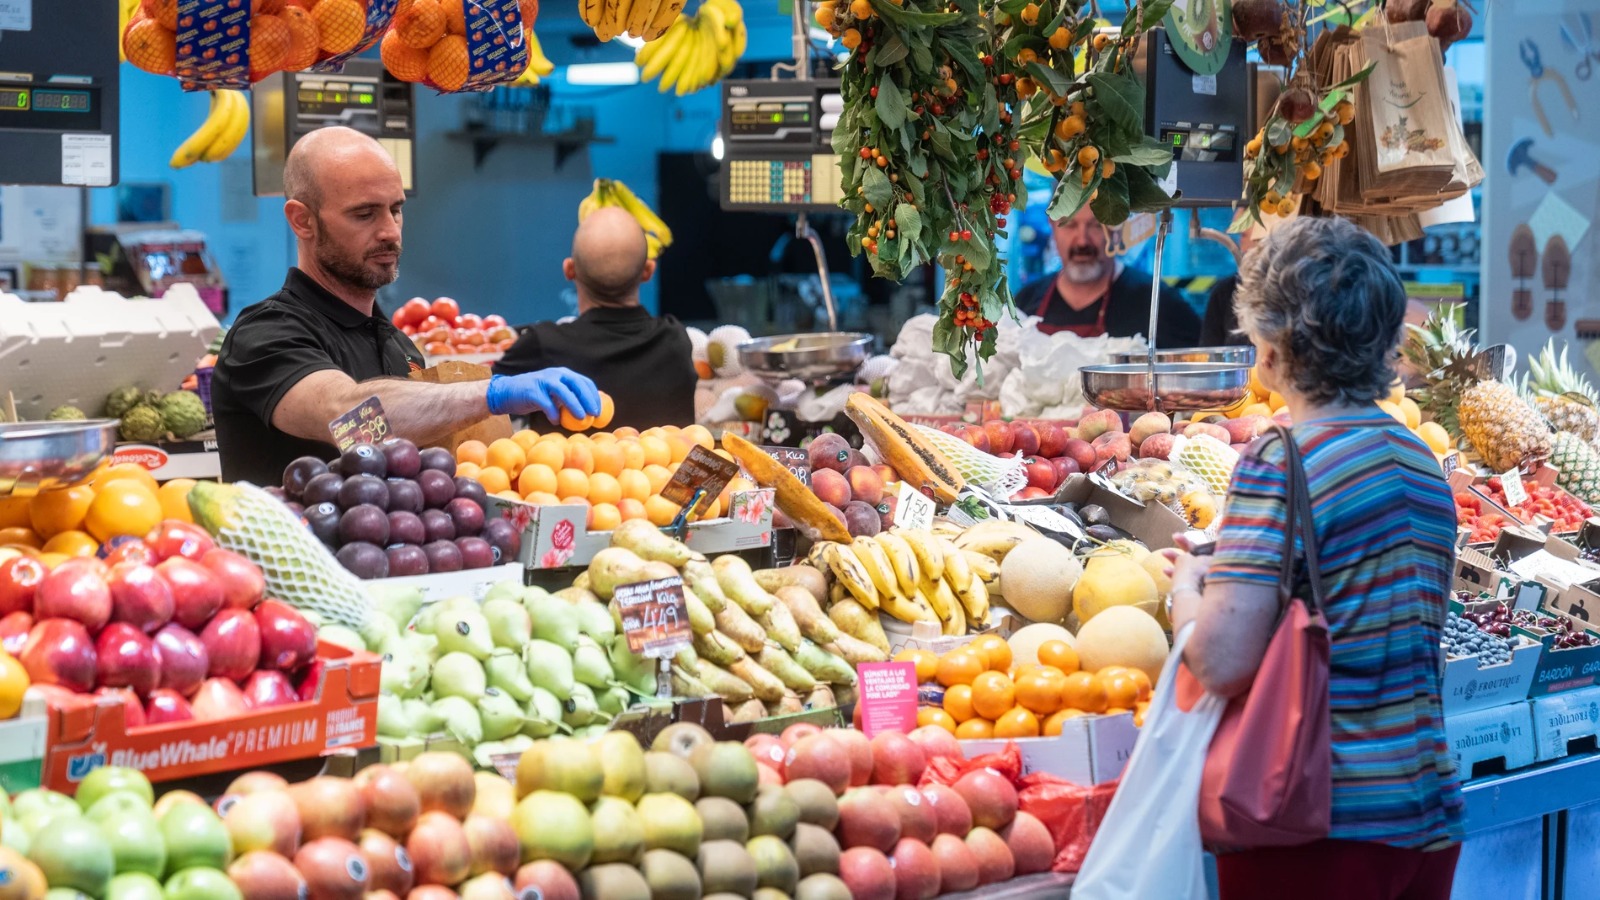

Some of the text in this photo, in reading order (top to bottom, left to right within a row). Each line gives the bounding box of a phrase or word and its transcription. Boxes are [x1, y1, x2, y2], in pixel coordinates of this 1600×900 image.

[896, 676, 905, 684] DE
[865, 685, 875, 693] LA
[233, 718, 317, 756] PREMIUM
